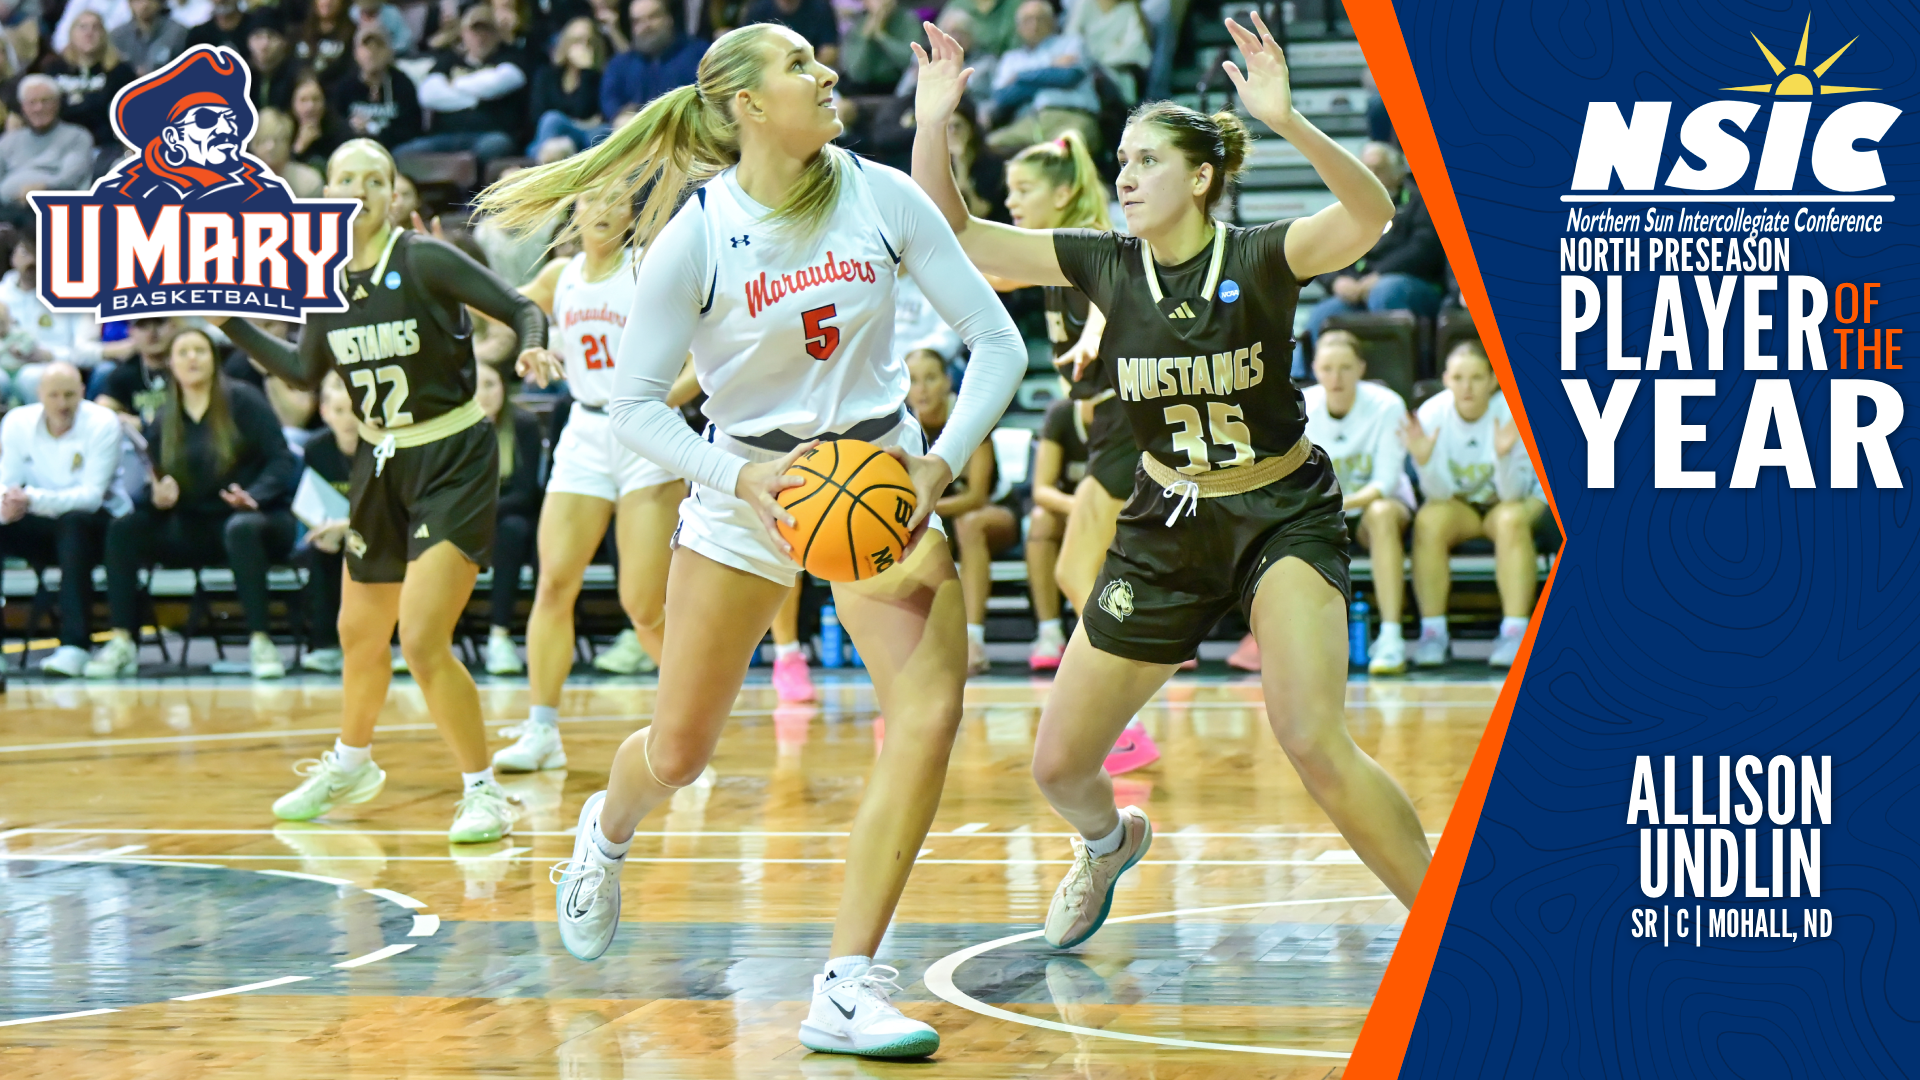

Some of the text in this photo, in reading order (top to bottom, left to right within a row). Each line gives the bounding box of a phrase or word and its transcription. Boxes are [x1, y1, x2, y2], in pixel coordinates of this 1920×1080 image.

[744, 250, 876, 319] Marauders
[1221, 289, 1239, 299] NCAA
[581, 334, 615, 370] 21
[801, 302, 840, 361] 5
[349, 364, 414, 429] 22
[1117, 341, 1265, 402] MUSTANGS
[1163, 401, 1256, 476] 35
